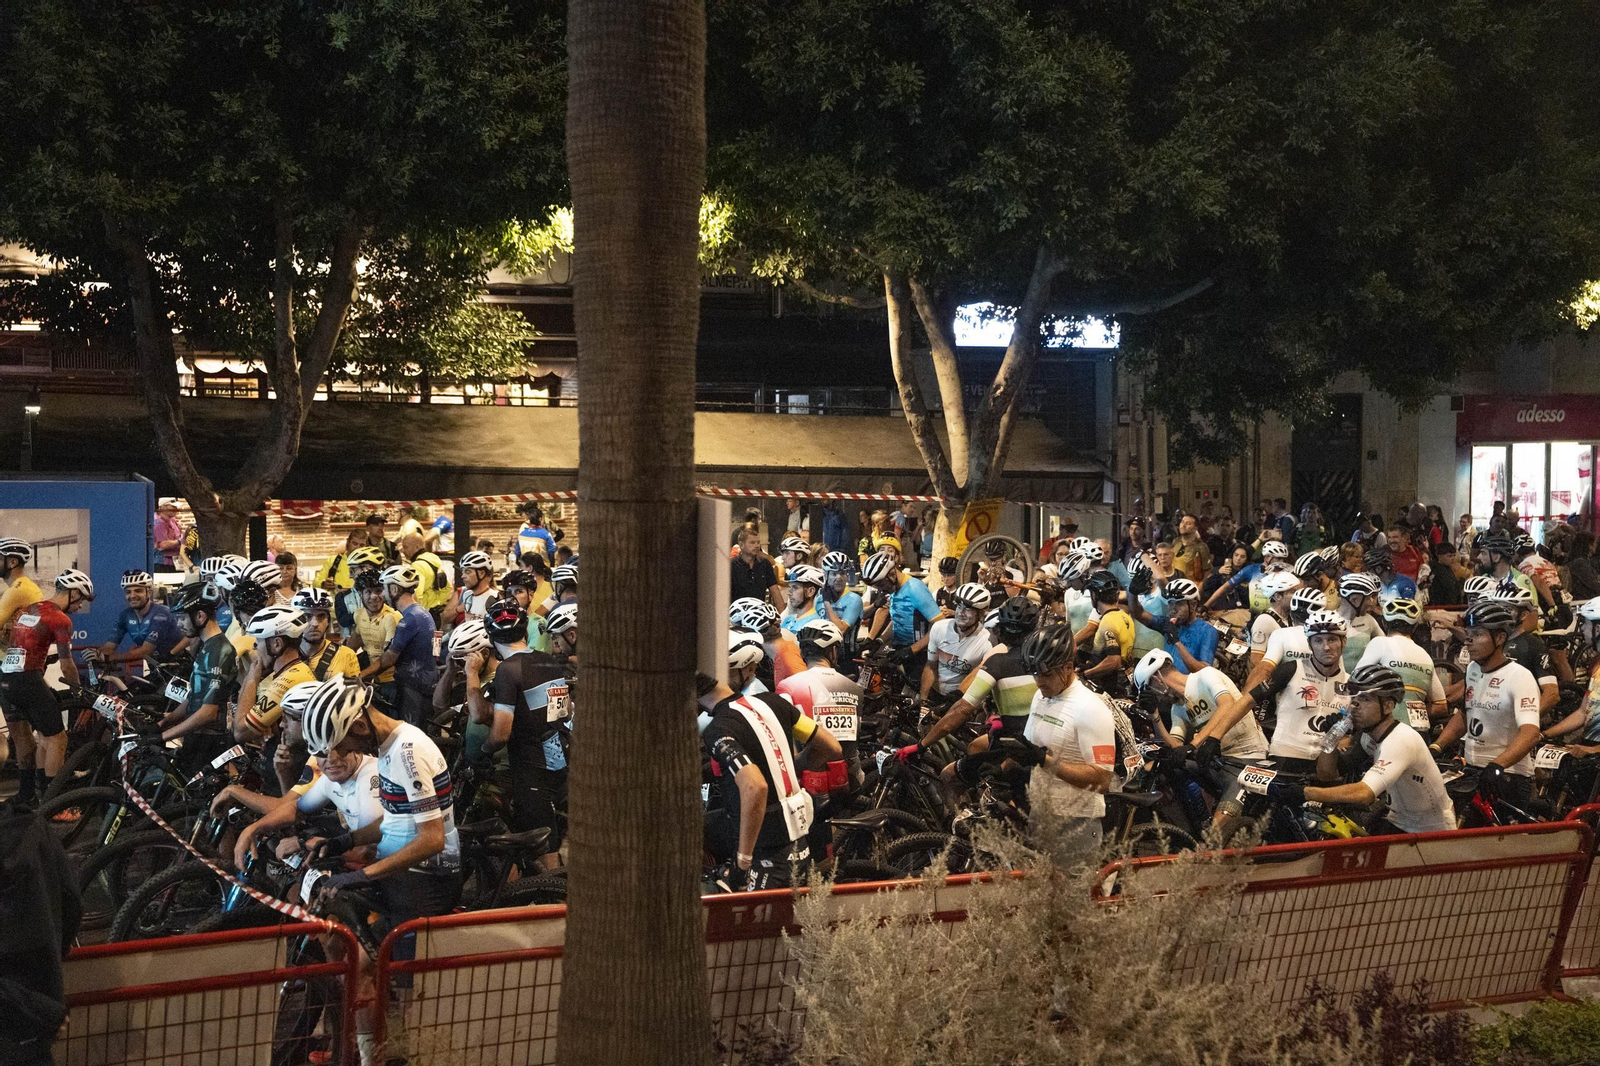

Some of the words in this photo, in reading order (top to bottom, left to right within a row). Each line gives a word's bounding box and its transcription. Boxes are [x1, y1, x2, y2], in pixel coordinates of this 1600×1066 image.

[1517, 404, 1566, 423] adesso
[1389, 660, 1424, 673] GUARDIA
[1489, 677, 1504, 686] EV
[1520, 697, 1535, 706] EV
[825, 716, 853, 729] 6323
[1541, 749, 1561, 760] 7261
[406, 750, 419, 778] REALE
[1244, 773, 1270, 785] 6982
